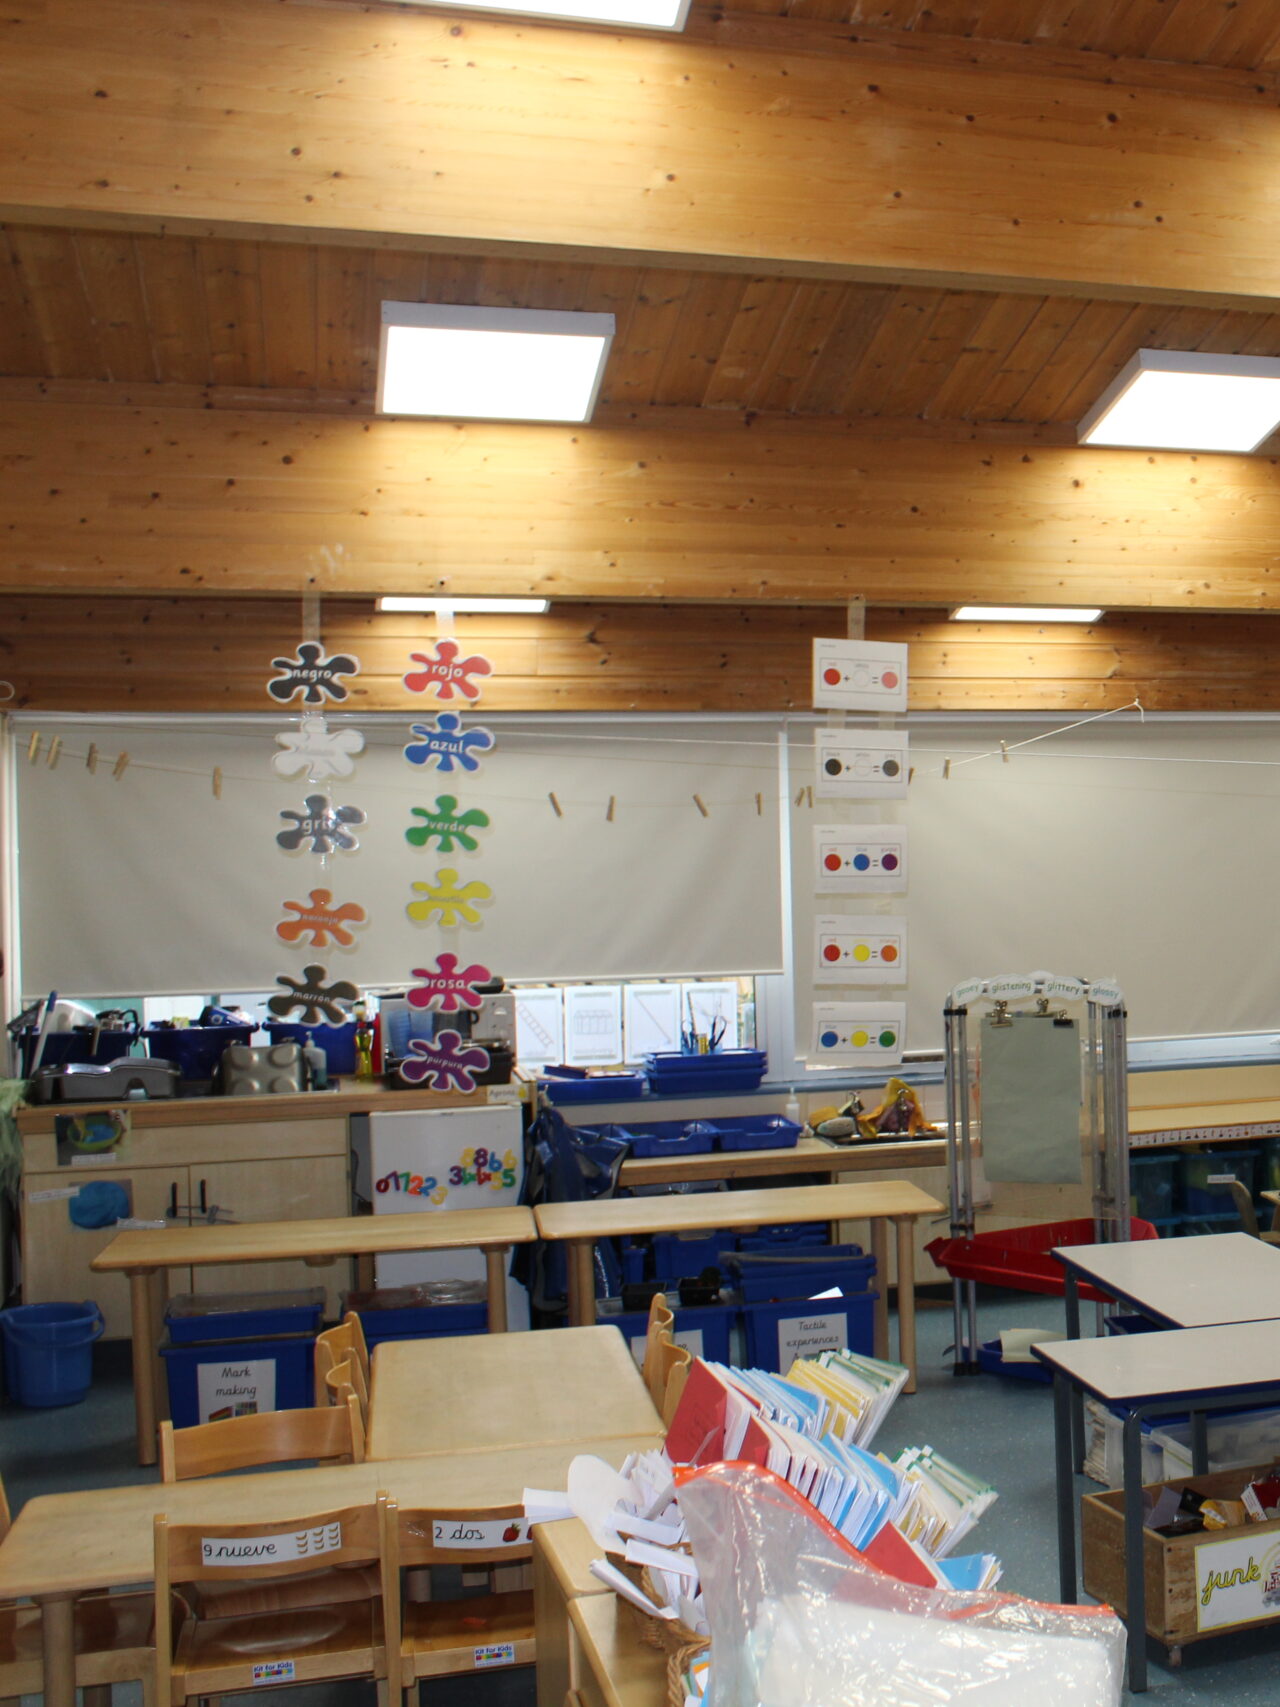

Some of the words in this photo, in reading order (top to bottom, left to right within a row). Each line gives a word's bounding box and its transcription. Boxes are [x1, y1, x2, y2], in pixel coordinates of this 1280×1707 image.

[292, 668, 332, 682] negro
[431, 663, 464, 681] rojo
[429, 738, 464, 754] azul
[428, 820, 466, 833] verde
[430, 976, 466, 989] rosa
[992, 980, 1032, 994] glistening
[1047, 981, 1081, 996] glittery
[786, 1335, 839, 1349] experiences
[221, 1366, 251, 1378] Mark
[216, 1385, 257, 1400] making
[434, 1526, 443, 1539] 2
[449, 1523, 486, 1541] dos
[203, 1543, 213, 1557] 9
[215, 1543, 277, 1558] nueve
[1201, 1556, 1261, 1606] junk
[475, 1647, 485, 1656] Kit
[486, 1645, 497, 1654] for
[498, 1644, 512, 1653] Kids
[253, 1664, 263, 1673] Kit
[264, 1663, 276, 1672] for
[277, 1661, 293, 1671] Kids
